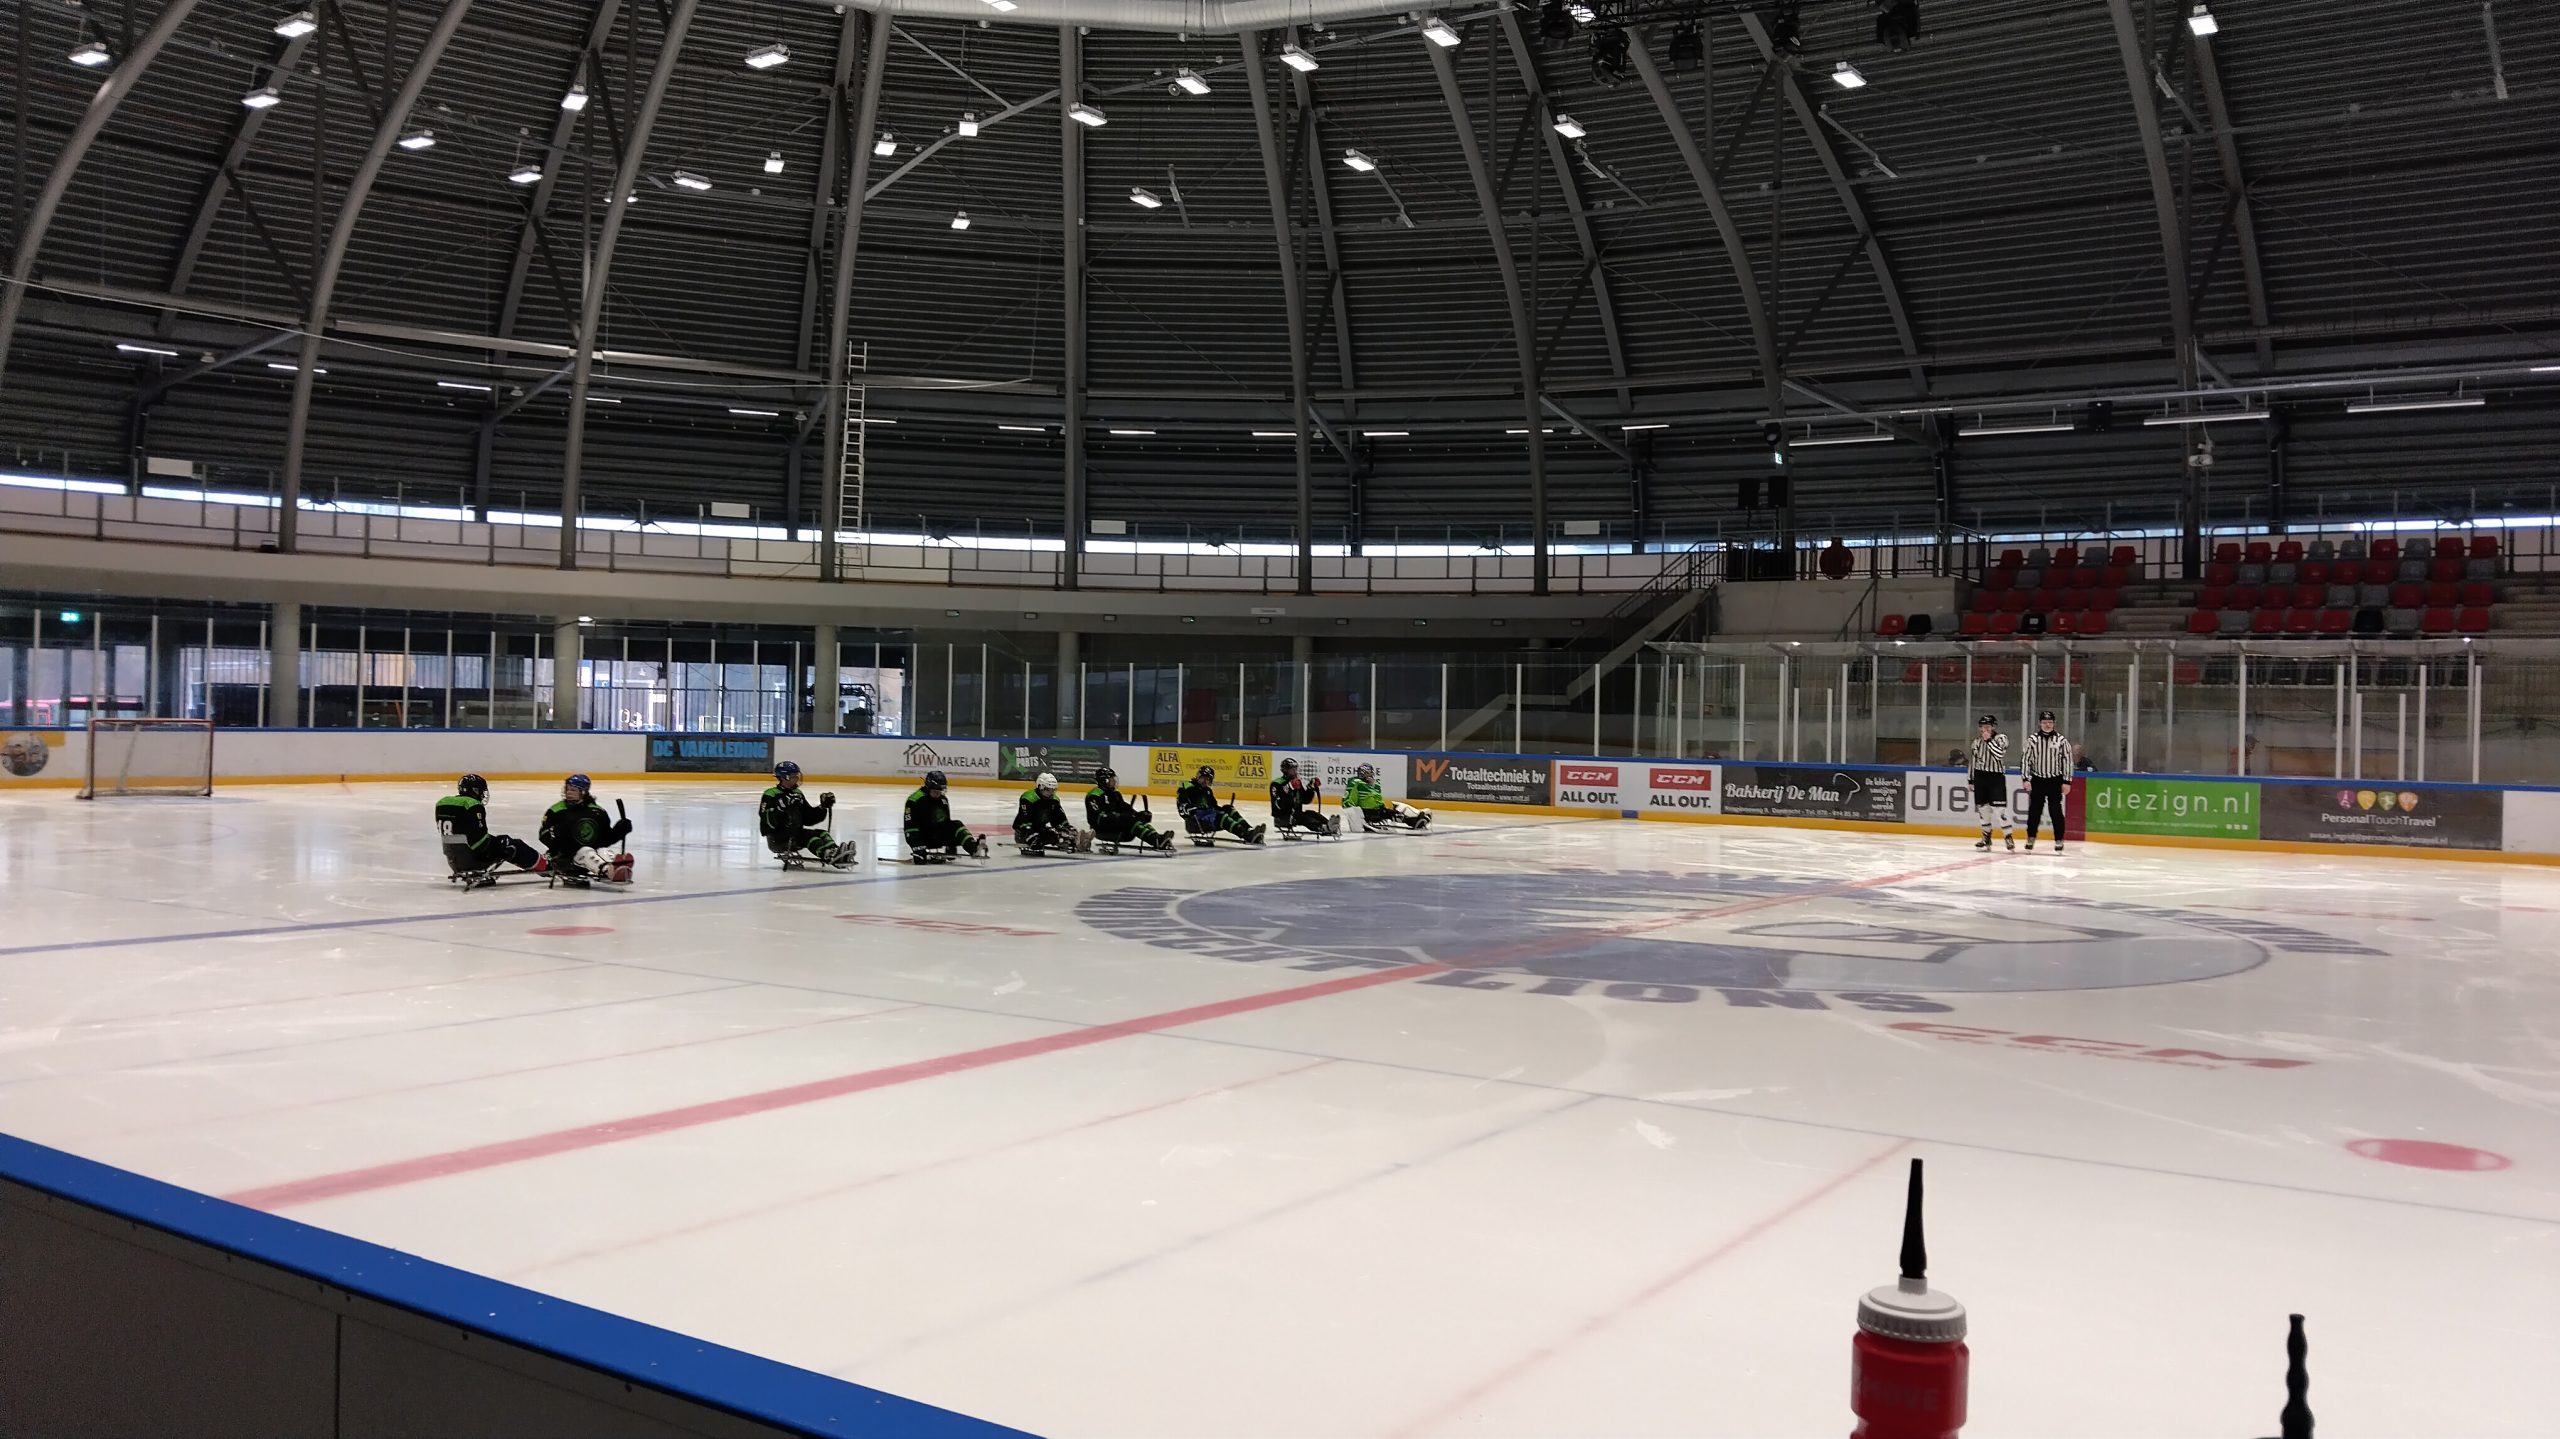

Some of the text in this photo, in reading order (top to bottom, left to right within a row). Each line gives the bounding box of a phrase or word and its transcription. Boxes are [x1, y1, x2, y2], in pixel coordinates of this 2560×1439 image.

[937, 756, 991, 768] MAKELAAR
[1157, 751, 1179, 763] ALFA
[1240, 754, 1263, 766] ALFA
[1155, 762, 1180, 774] GLAS
[1238, 765, 1264, 777] GLAS
[1327, 766, 1381, 776] OFFSHE
[1449, 766, 1530, 784] Totaaltechniek
[1532, 769, 1546, 784] bv
[1566, 769, 1614, 782] CCM
[1656, 773, 1705, 786] CCM
[1560, 790, 1619, 805] ALL OUT.
[1725, 782, 1840, 804] Bakkerij De Man
[1650, 794, 1711, 809] ALL OUT.
[2095, 787, 2250, 816] diezign.nl
[1415, 969, 1957, 1014] LIONS
